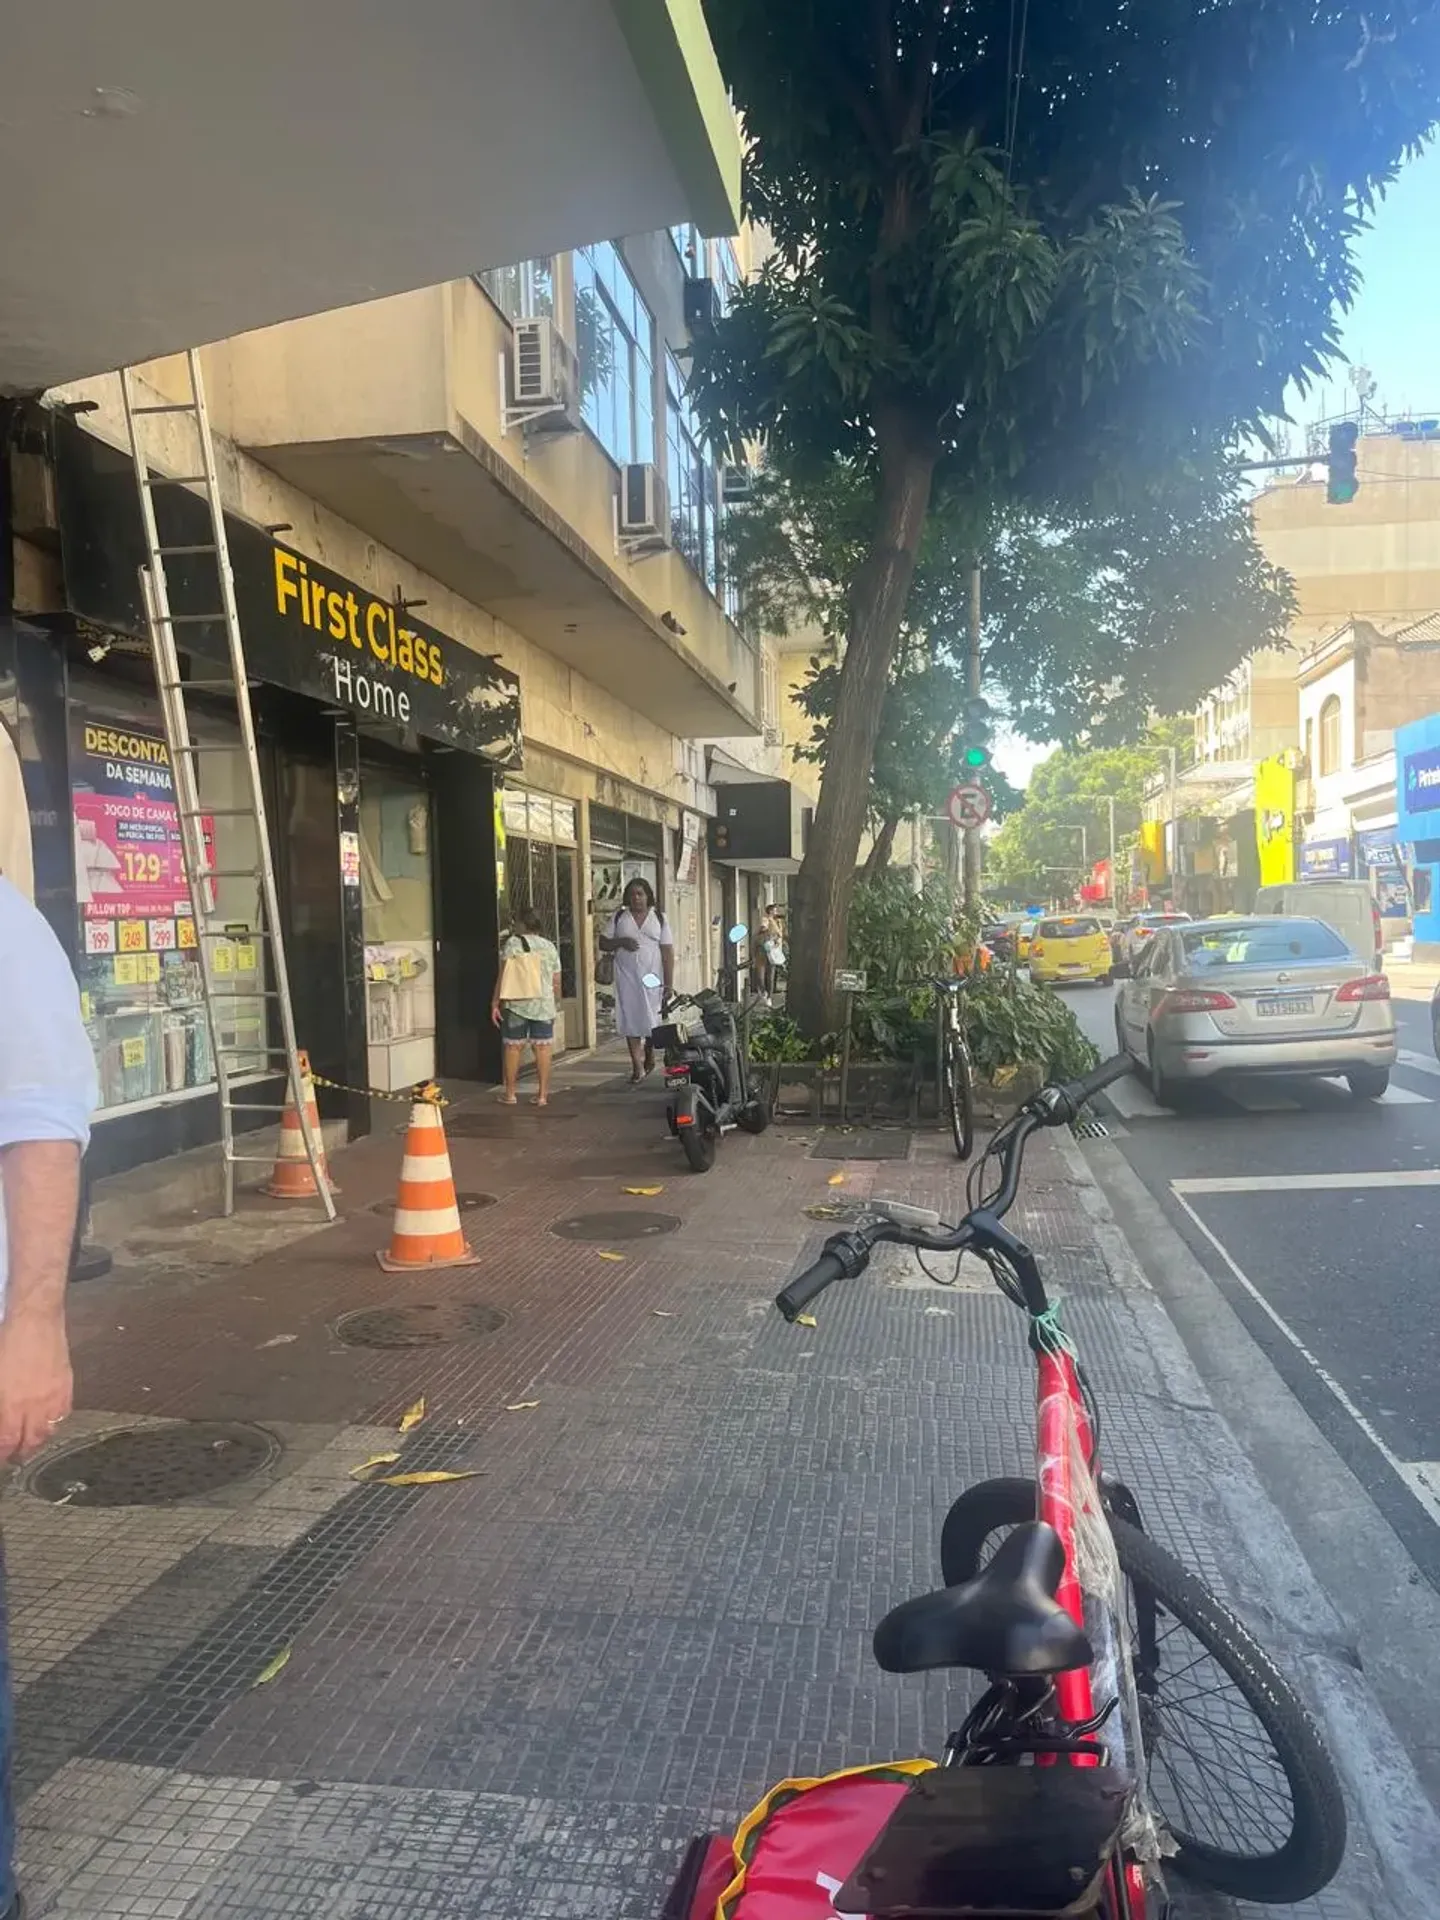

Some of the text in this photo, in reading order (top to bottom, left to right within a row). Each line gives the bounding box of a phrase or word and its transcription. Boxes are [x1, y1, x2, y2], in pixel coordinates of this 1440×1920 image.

[274, 547, 443, 687] First Class
[333, 655, 411, 722] Home
[106, 762, 173, 790] DA SEMANA
[103, 803, 131, 818] JOGO
[132, 805, 145, 820] DE
[146, 808, 173, 822] CAMA
[125, 852, 161, 882] 129
[86, 902, 116, 916] PILLOW
[92, 932, 110, 949] 199
[154, 930, 171, 947] 299
